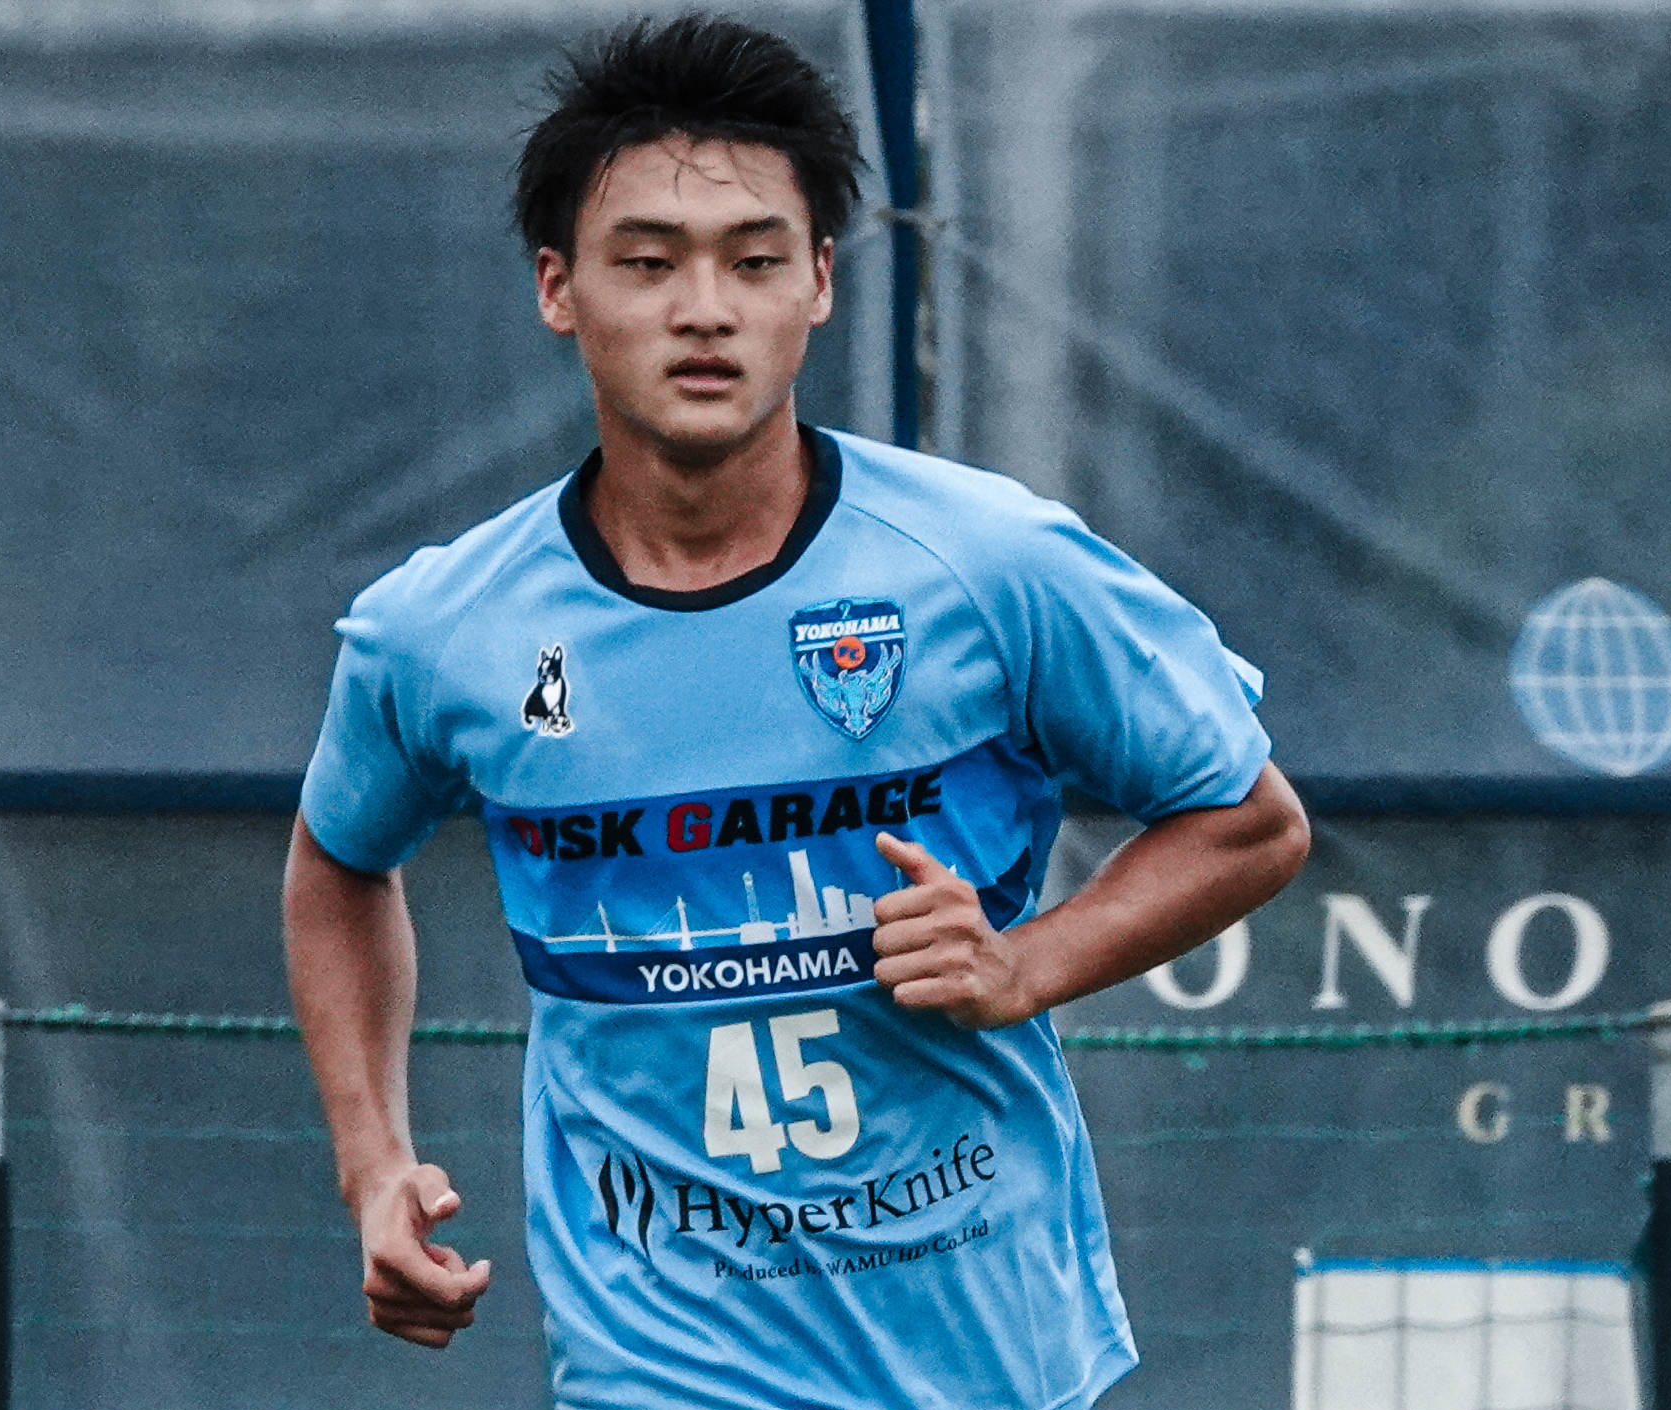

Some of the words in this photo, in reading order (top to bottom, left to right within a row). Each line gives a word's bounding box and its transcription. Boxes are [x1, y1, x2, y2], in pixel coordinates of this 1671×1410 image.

[795, 614, 901, 643] YOKOHAMA
[667, 772, 942, 854] GARAGE
[638, 946, 860, 994] YOKOHAMA
[703, 1008, 861, 1175] 45
